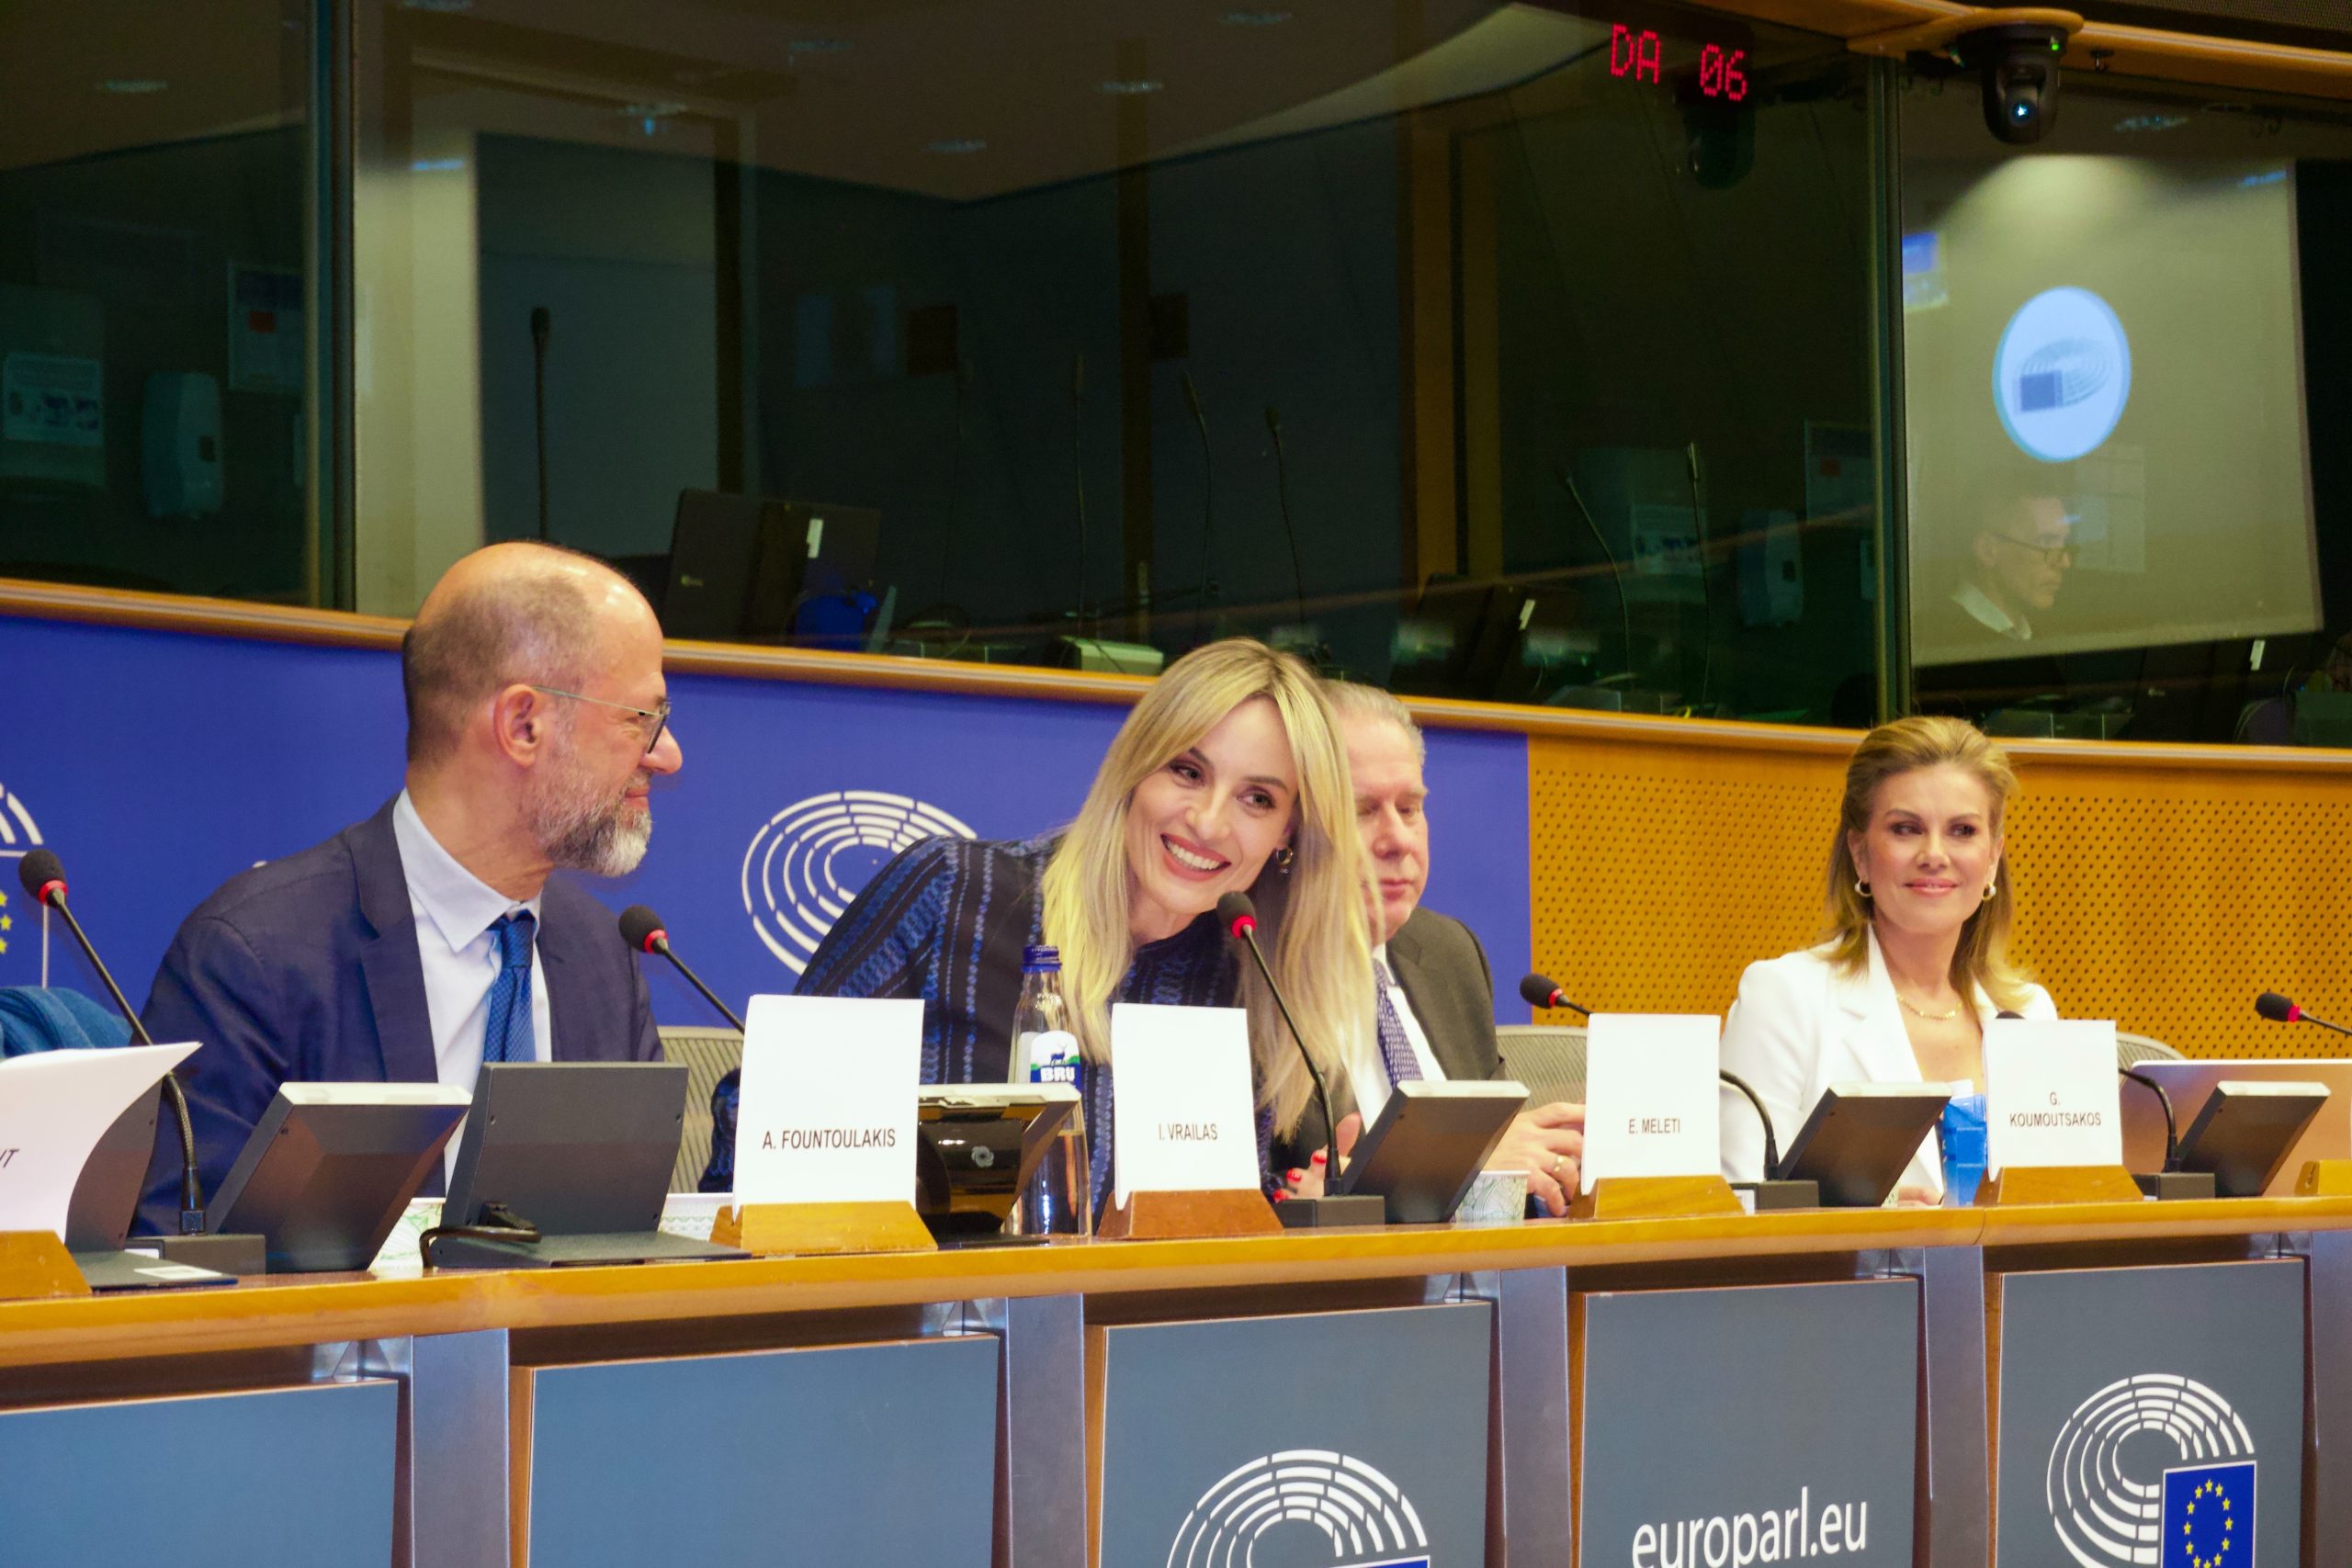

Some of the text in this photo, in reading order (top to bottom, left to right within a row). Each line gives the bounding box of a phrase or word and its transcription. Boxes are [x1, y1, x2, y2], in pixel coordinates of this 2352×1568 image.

[1611, 23, 1747, 101] DA 06
[1040, 1066, 1075, 1082] BRU
[2049, 1091, 2061, 1106] G.
[1628, 1118, 1680, 1134] E. MELETI
[2009, 1111, 2101, 1127] KOUMOUTSAKOS
[762, 1128, 896, 1149] A. FOUNTOULAKIS
[1159, 1122, 1217, 1140] I. VRAILAS
[1632, 1486, 1867, 1568] europarl.eu
